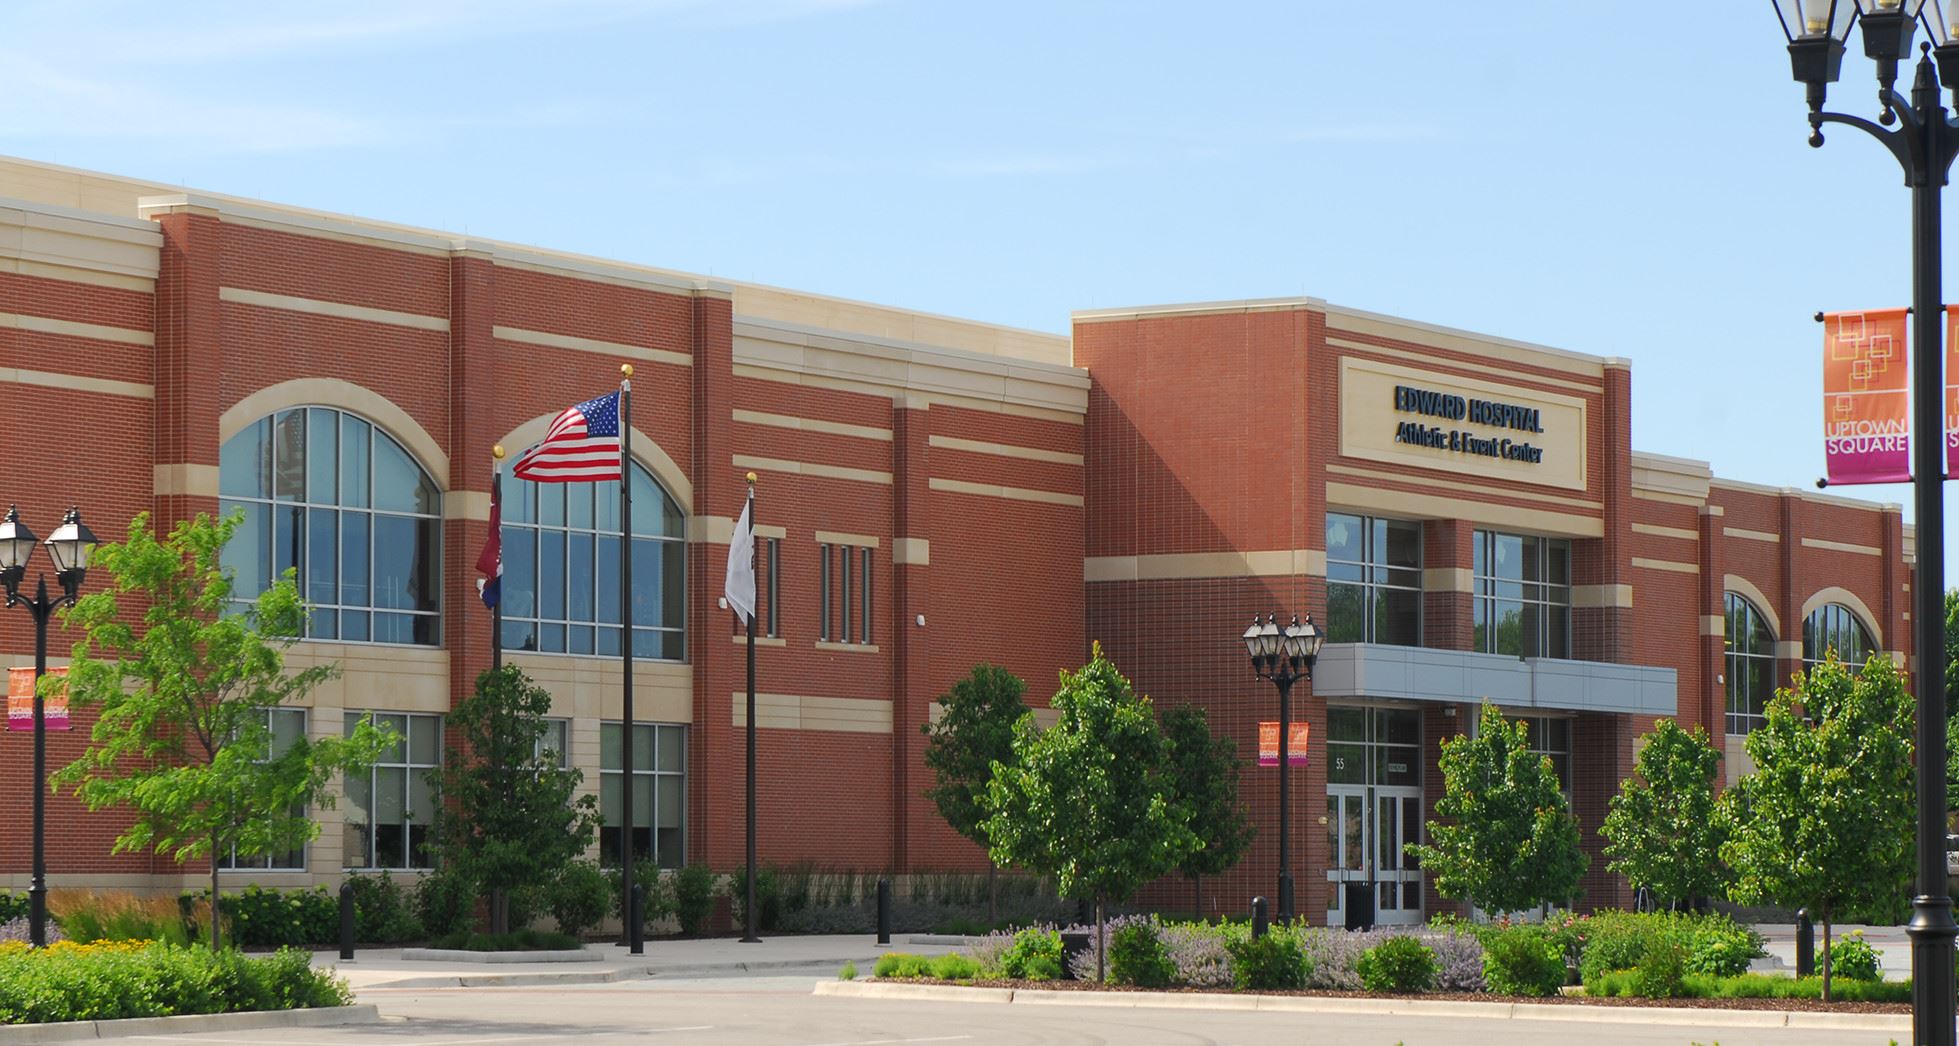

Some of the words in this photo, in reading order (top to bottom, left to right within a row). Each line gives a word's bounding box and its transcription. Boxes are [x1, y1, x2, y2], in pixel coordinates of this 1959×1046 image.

[1395, 385, 1466, 420] EDWARD
[1469, 399, 1544, 433] HOSPITAL
[1827, 419, 1905, 437] UPTOWN
[1398, 422, 1448, 449] Athletic
[1450, 430, 1460, 452] &
[1462, 432, 1499, 457] Event
[1501, 438, 1543, 463] Center
[1828, 436, 1906, 455] SQUARE
[1336, 758, 1345, 770] 55
